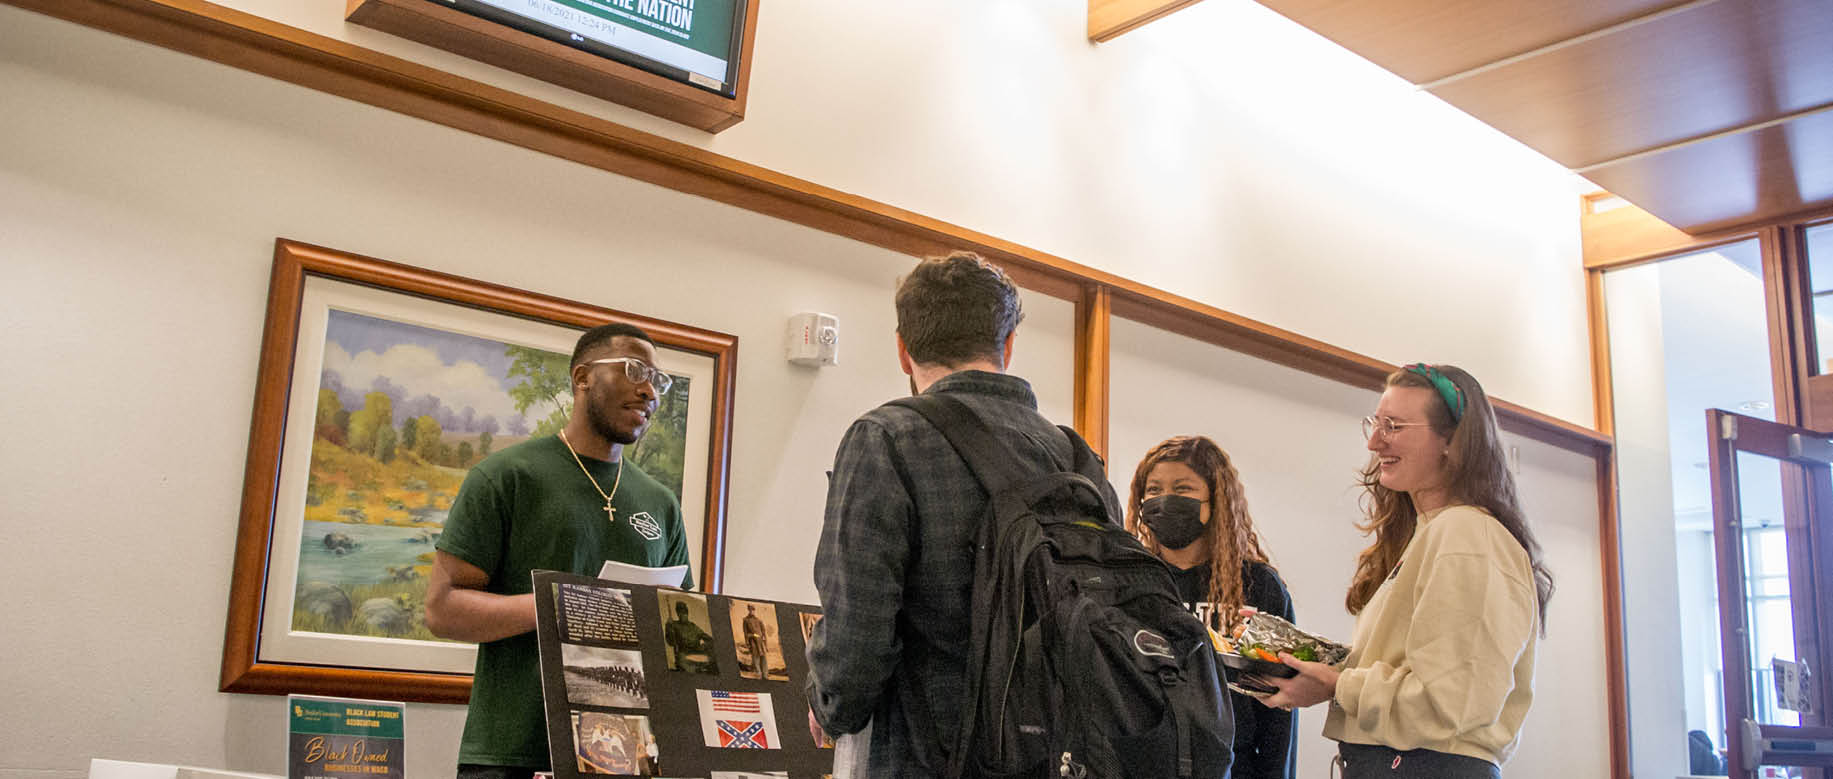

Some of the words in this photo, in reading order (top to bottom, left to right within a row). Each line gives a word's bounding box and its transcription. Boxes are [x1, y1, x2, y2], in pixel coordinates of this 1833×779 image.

[637, 0, 693, 31] NATION
[601, 23, 617, 37] PM
[346, 708, 364, 716] BLACK
[364, 709, 377, 717] LAW
[377, 710, 400, 719] STUDENT
[304, 736, 348, 764] Black
[351, 739, 390, 765] Owned
